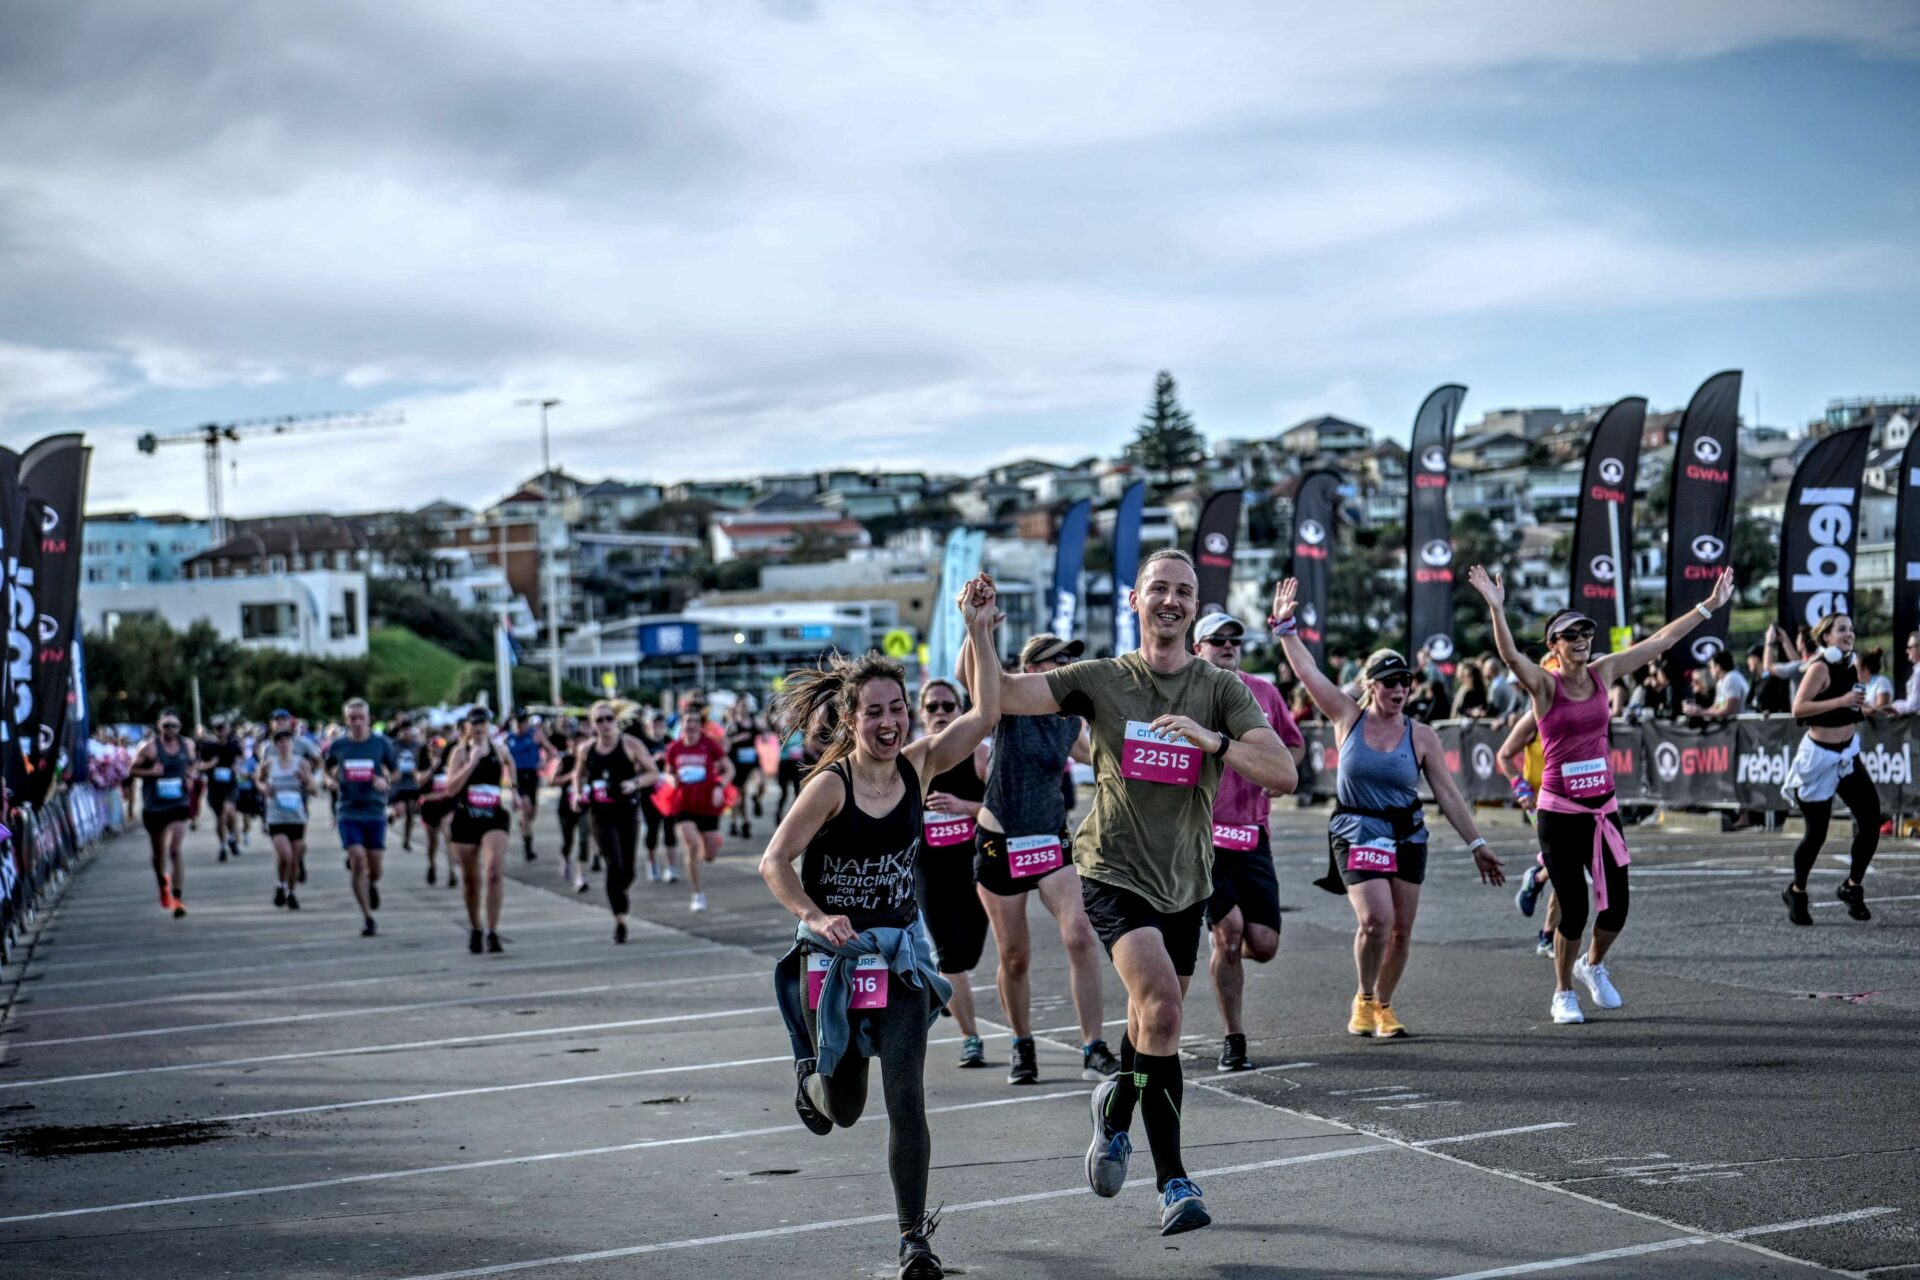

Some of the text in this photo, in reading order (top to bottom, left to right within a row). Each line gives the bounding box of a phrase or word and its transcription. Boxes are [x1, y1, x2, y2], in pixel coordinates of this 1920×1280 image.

[1133, 747, 1190, 770] 22515
[1681, 746, 1729, 776] GWM
[1570, 774, 1606, 790] 22354
[930, 822, 969, 838] 22553
[1214, 825, 1252, 842] 22621
[1015, 849, 1057, 867] 22355
[1355, 850, 1391, 866] 21628
